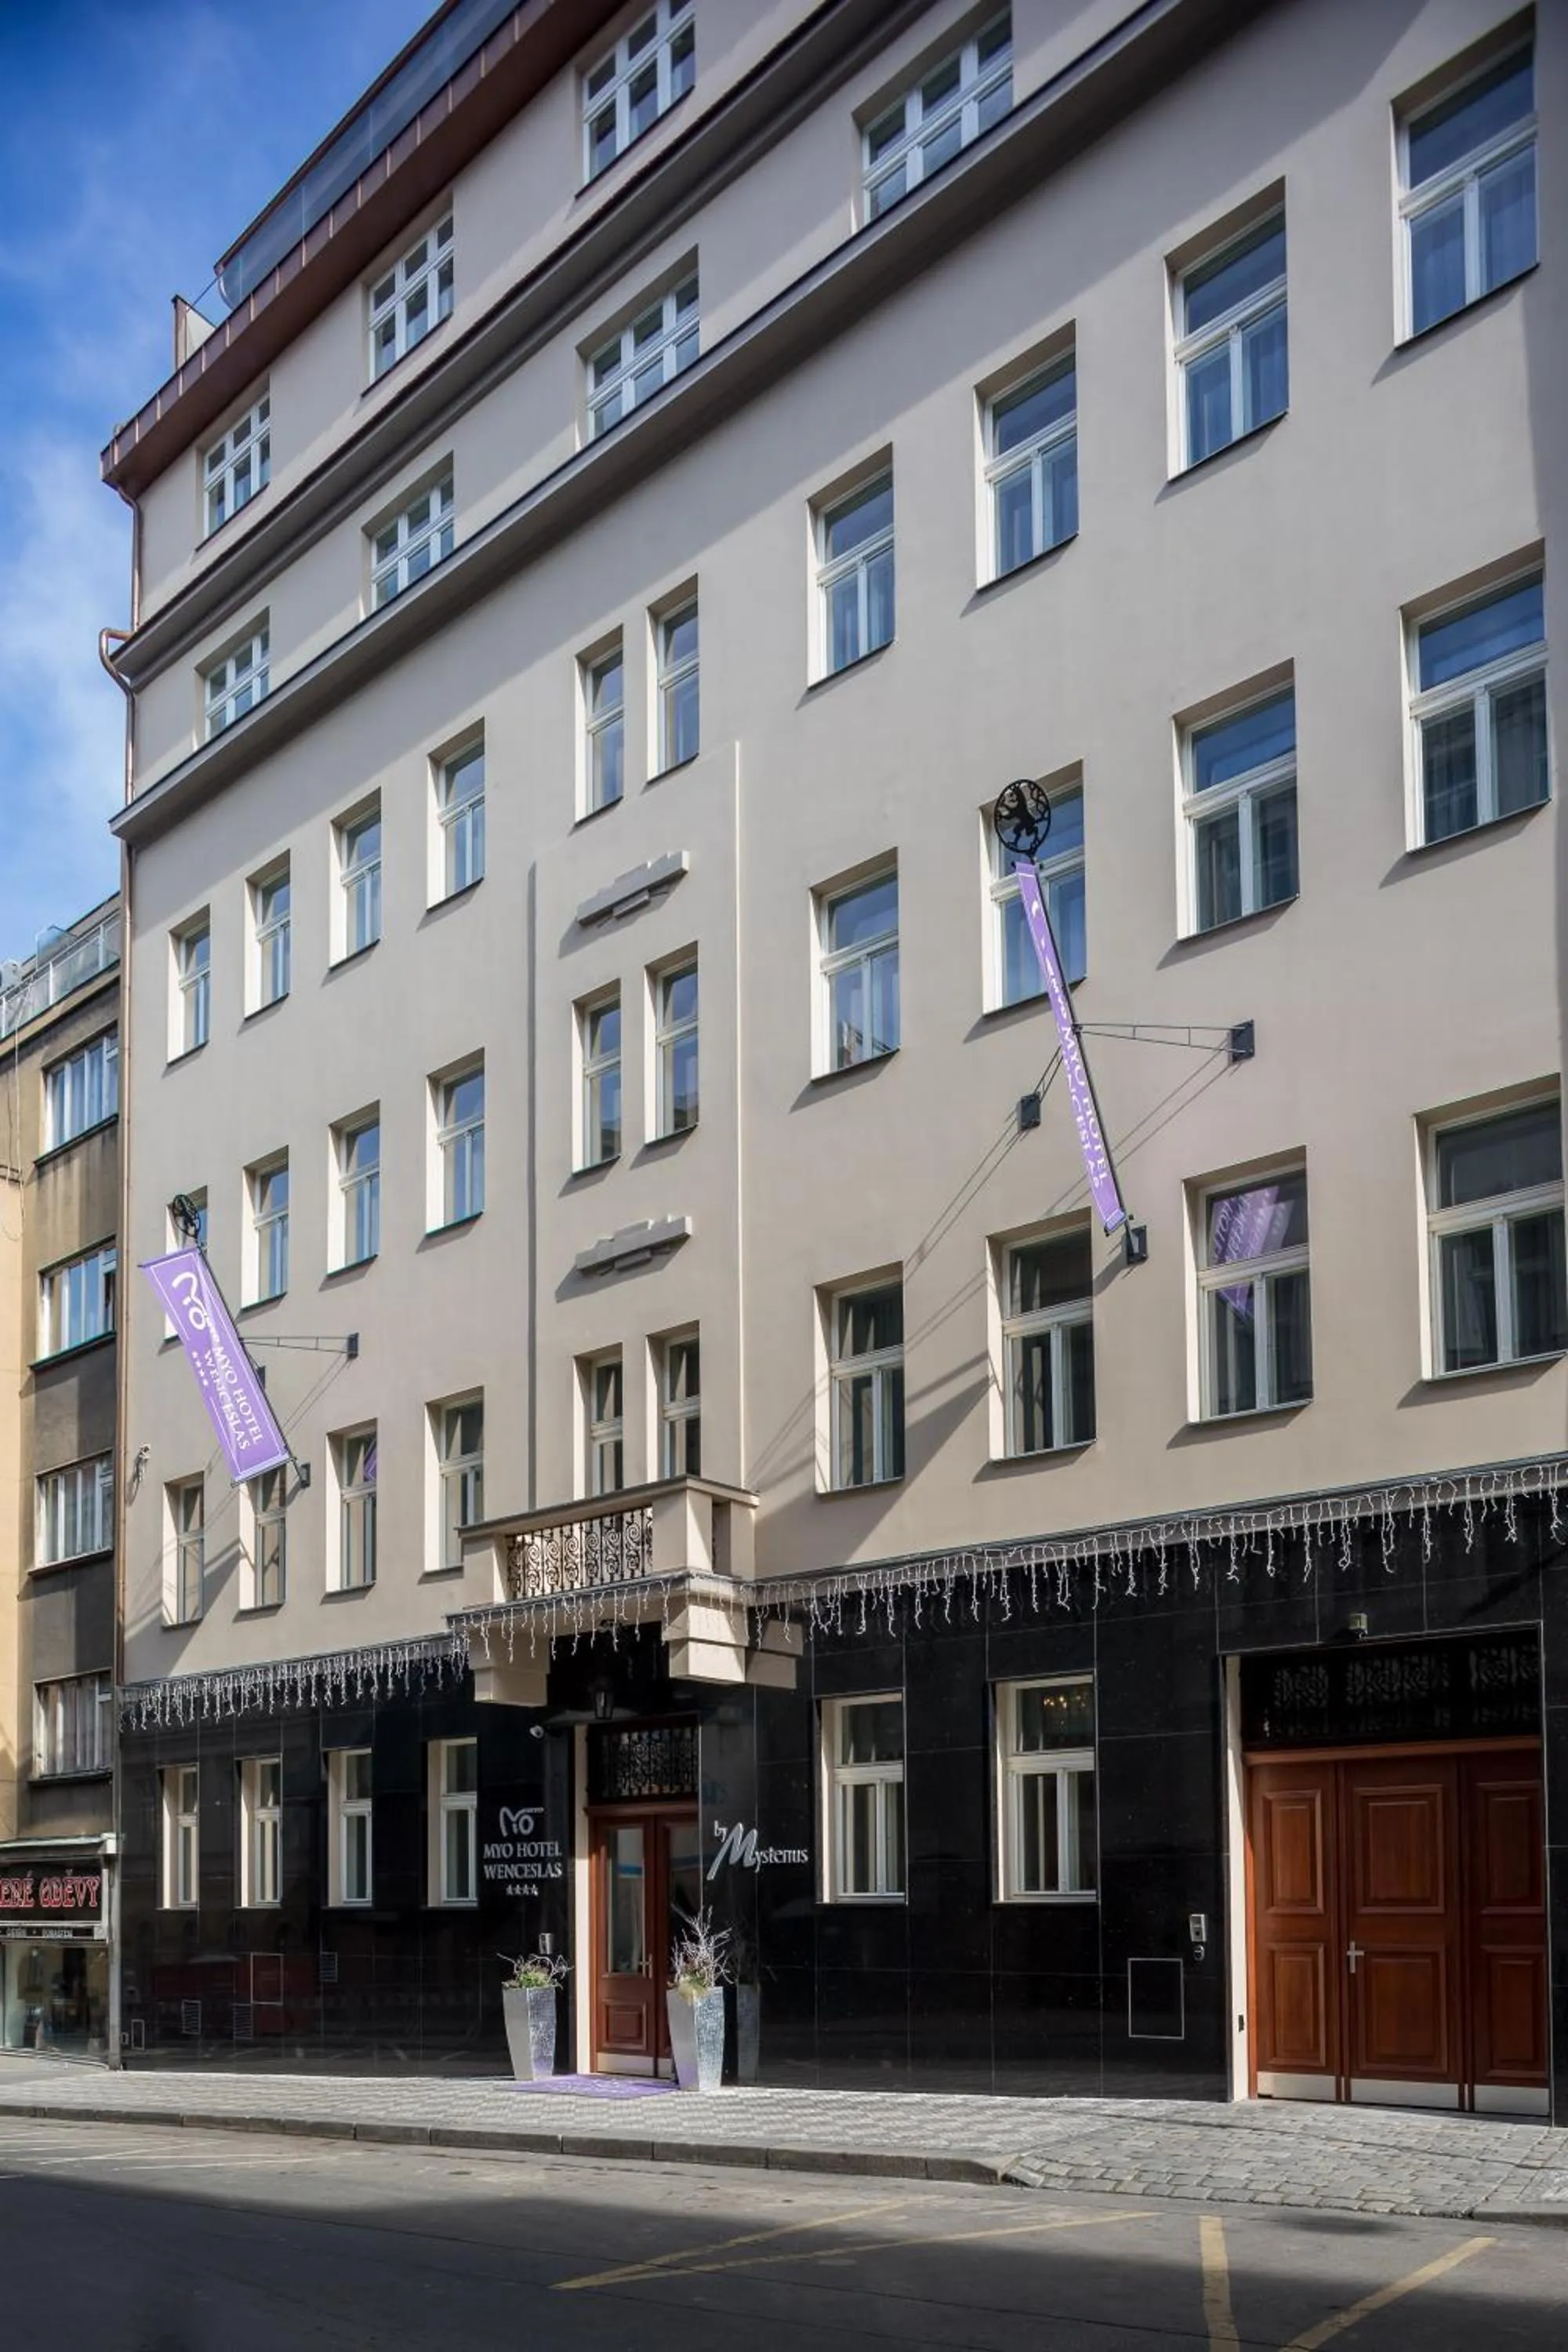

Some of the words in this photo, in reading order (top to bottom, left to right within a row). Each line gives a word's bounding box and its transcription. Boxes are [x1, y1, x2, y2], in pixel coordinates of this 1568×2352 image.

[205, 1349, 251, 1450] WENCESLAS
[212, 1345, 238, 1385] MYO
[234, 1385, 263, 1444] HOTEL
[714, 1820, 728, 1843] by
[483, 1842, 514, 1859] MYO
[517, 1841, 563, 1857] HOTEL
[484, 1862, 563, 1879] WENCESLAS
